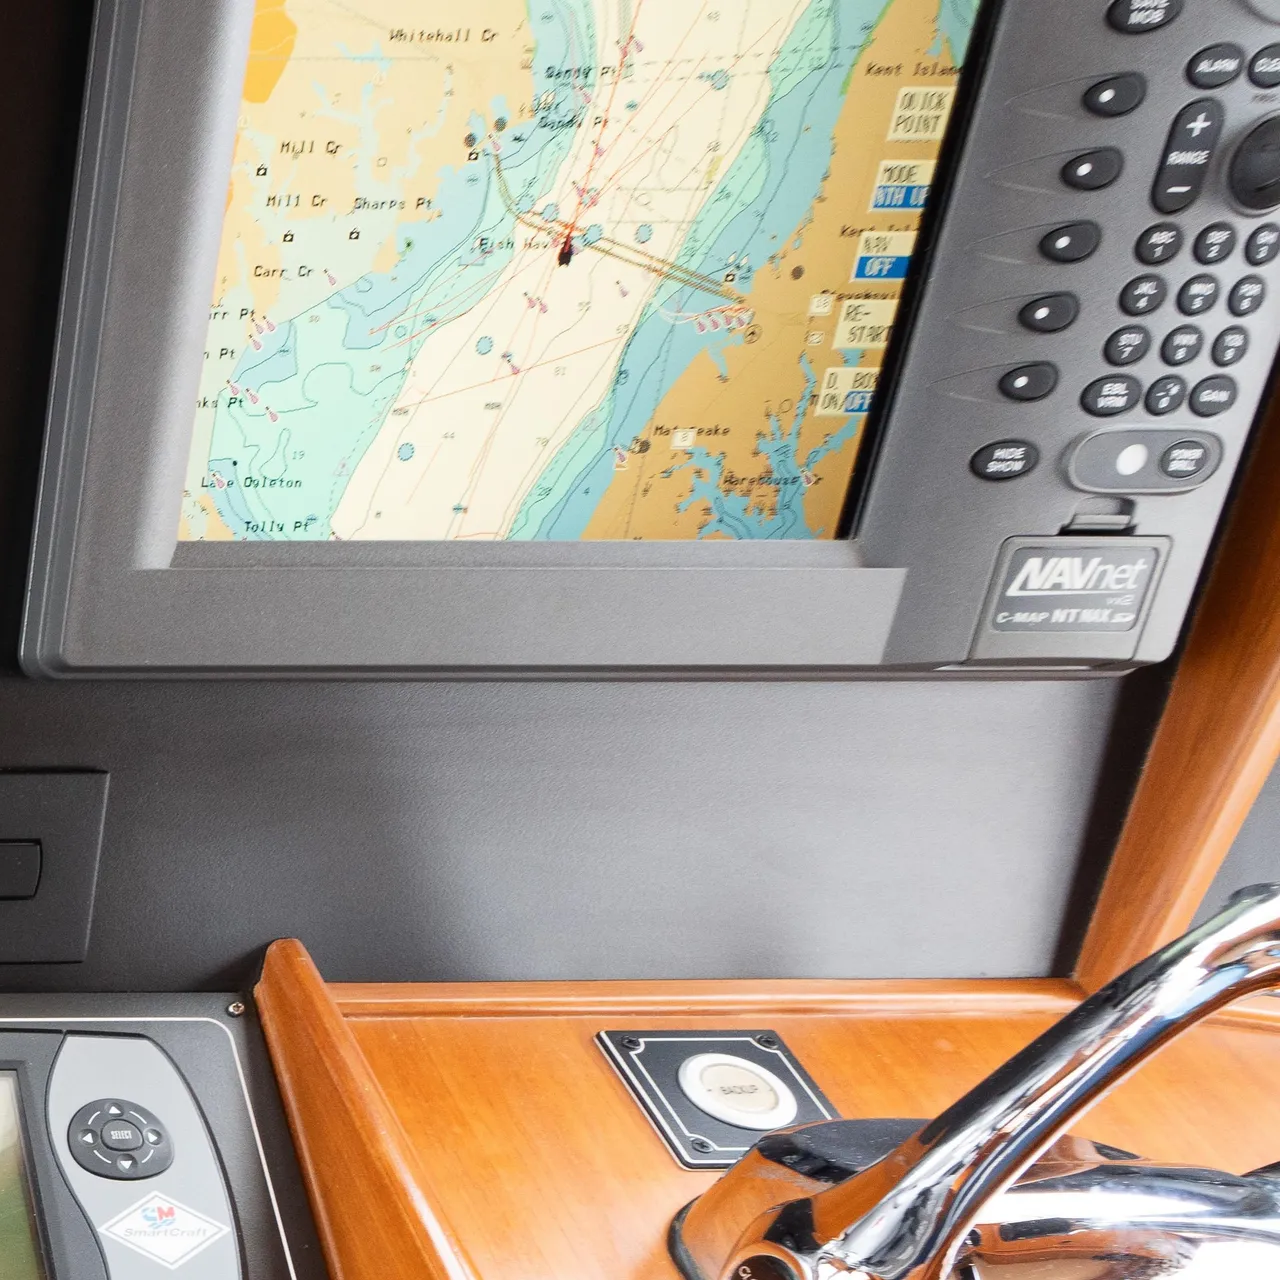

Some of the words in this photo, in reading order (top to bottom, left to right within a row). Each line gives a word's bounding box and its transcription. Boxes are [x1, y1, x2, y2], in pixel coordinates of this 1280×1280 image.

[280, 141, 314, 153] Mill
[266, 194, 301, 207] Mill
[254, 266, 285, 278] Carr
[298, 266, 314, 277] Cr
[228, 397, 244, 408] Pt
[201, 477, 234, 488] Lae
[244, 521, 284, 532] Tolly
[293, 521, 309, 532] Pt
[1006, 557, 1147, 592] NAVnet
[111, 1130, 132, 1140] SELECT
[123, 1228, 207, 1237] SmartCraft
